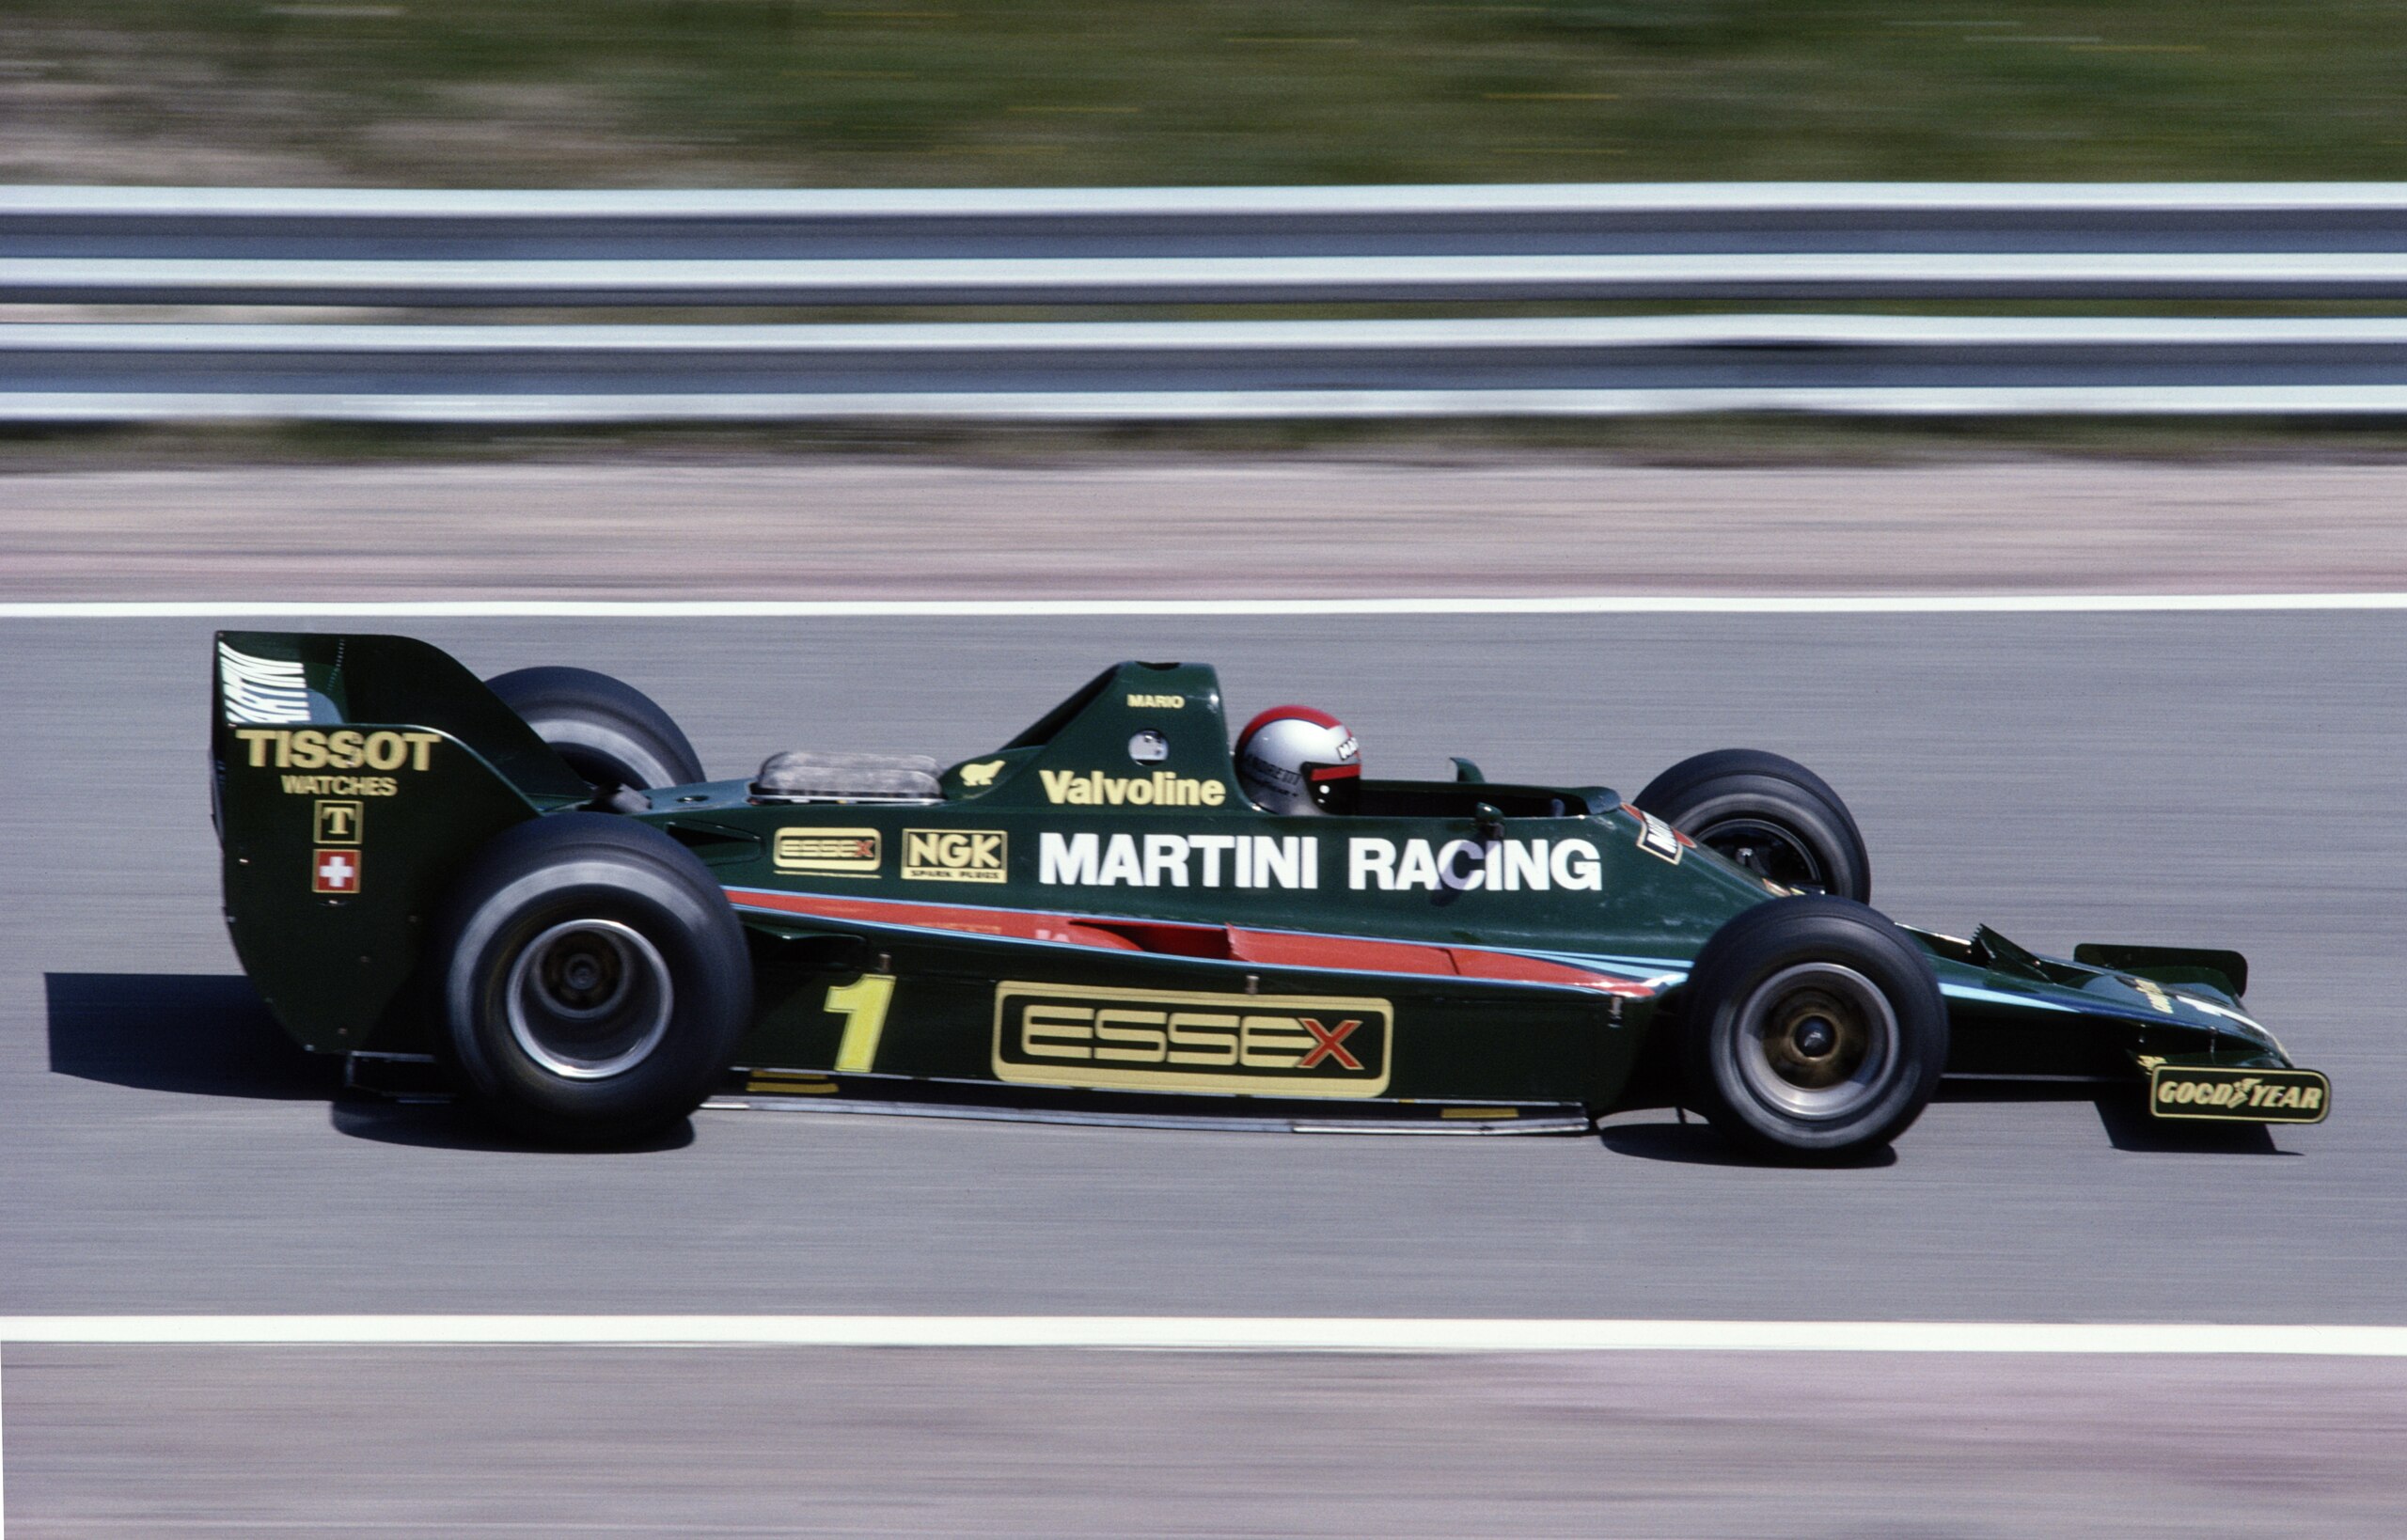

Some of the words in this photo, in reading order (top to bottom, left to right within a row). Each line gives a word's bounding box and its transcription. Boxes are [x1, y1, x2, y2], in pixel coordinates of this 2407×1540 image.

[1127, 694, 1185, 709] MARIO
[235, 730, 442, 771] TISSOT
[280, 775, 398, 796] WATCHES
[1039, 770, 1226, 806] Valvoline
[322, 807, 355, 835] T
[780, 839, 873, 857] ESSEX
[908, 833, 1001, 868] NGK
[1039, 832, 1318, 889] MARTINI
[1348, 838, 1602, 890] RACING
[823, 973, 897, 1073] 1
[1021, 1004, 1363, 1070] ESSEX
